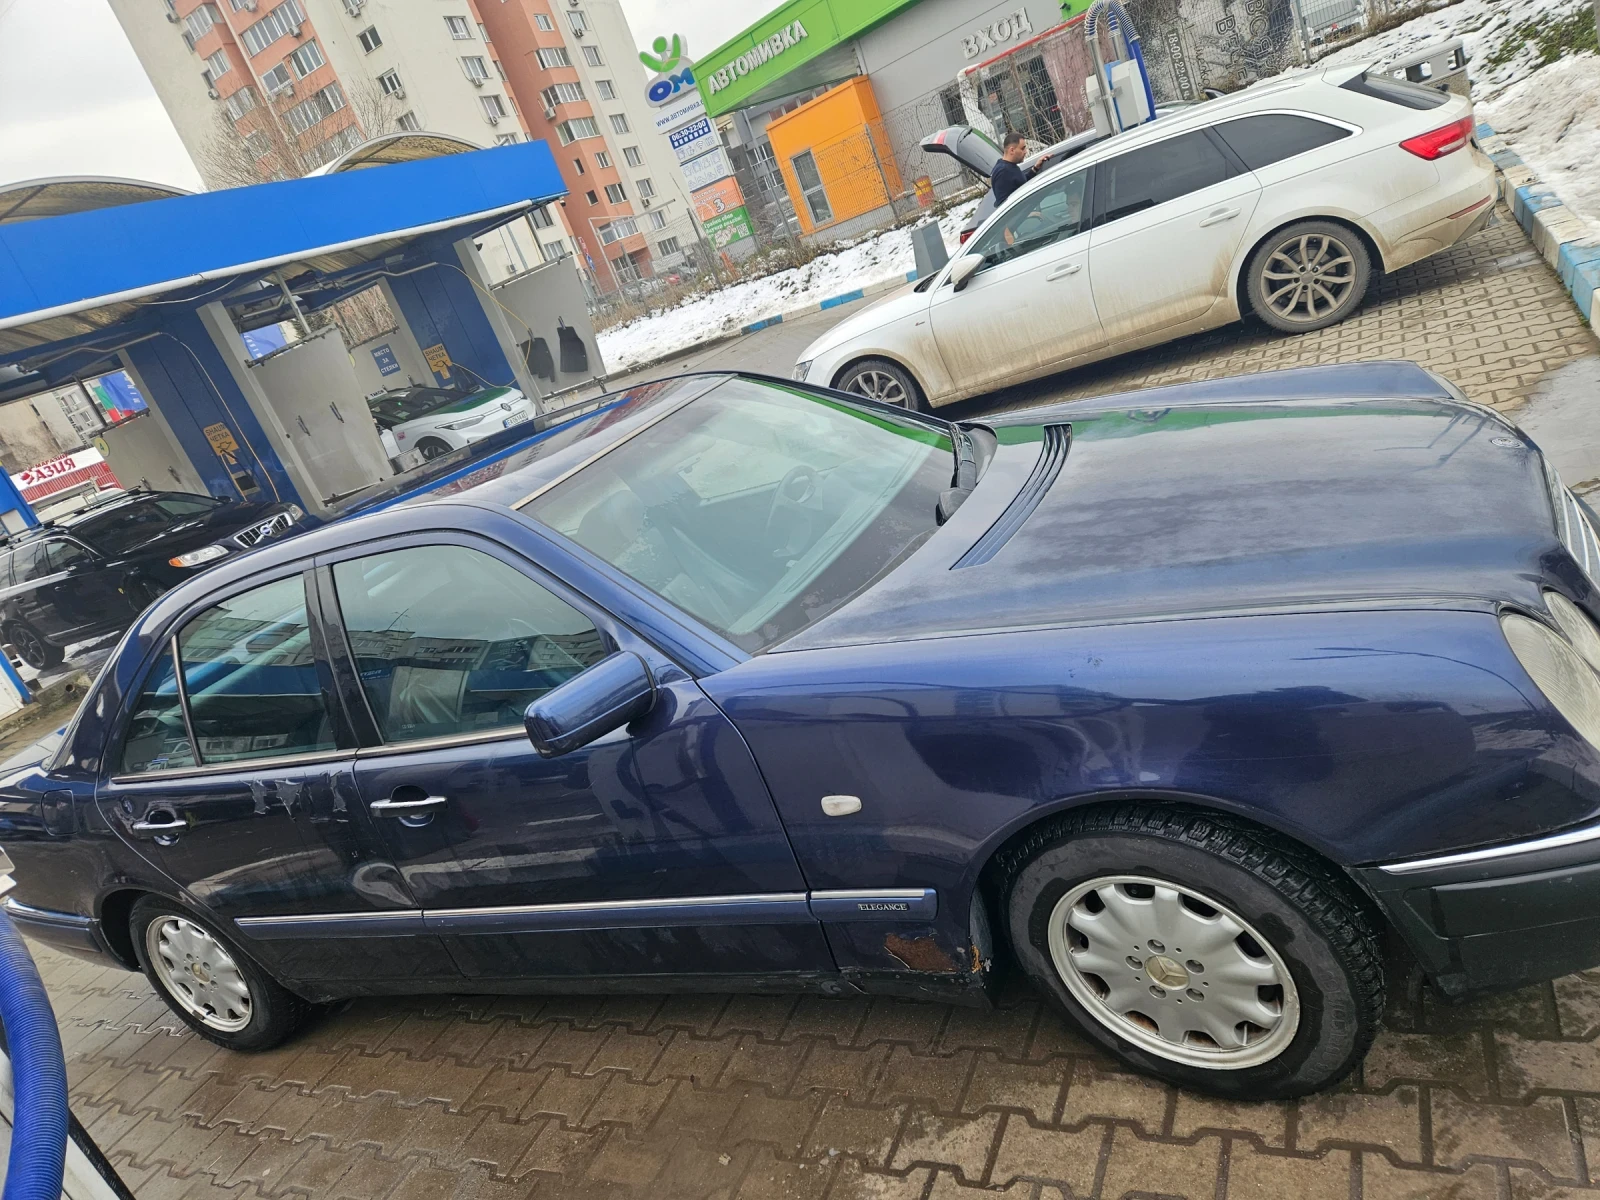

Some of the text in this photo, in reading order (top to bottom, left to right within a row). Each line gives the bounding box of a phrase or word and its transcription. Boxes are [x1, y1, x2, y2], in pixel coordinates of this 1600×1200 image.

[960, 7, 1033, 60] ВХОД
[708, 20, 808, 95] АВТОМИВКА
[713, 198, 725, 213] 3
[373, 347, 390, 358] МЯСТО
[35, 453, 69, 468] МАГАЗИН
[35, 457, 76, 483] АЗИЯ
[857, 903, 908, 911] ELEGANCE
